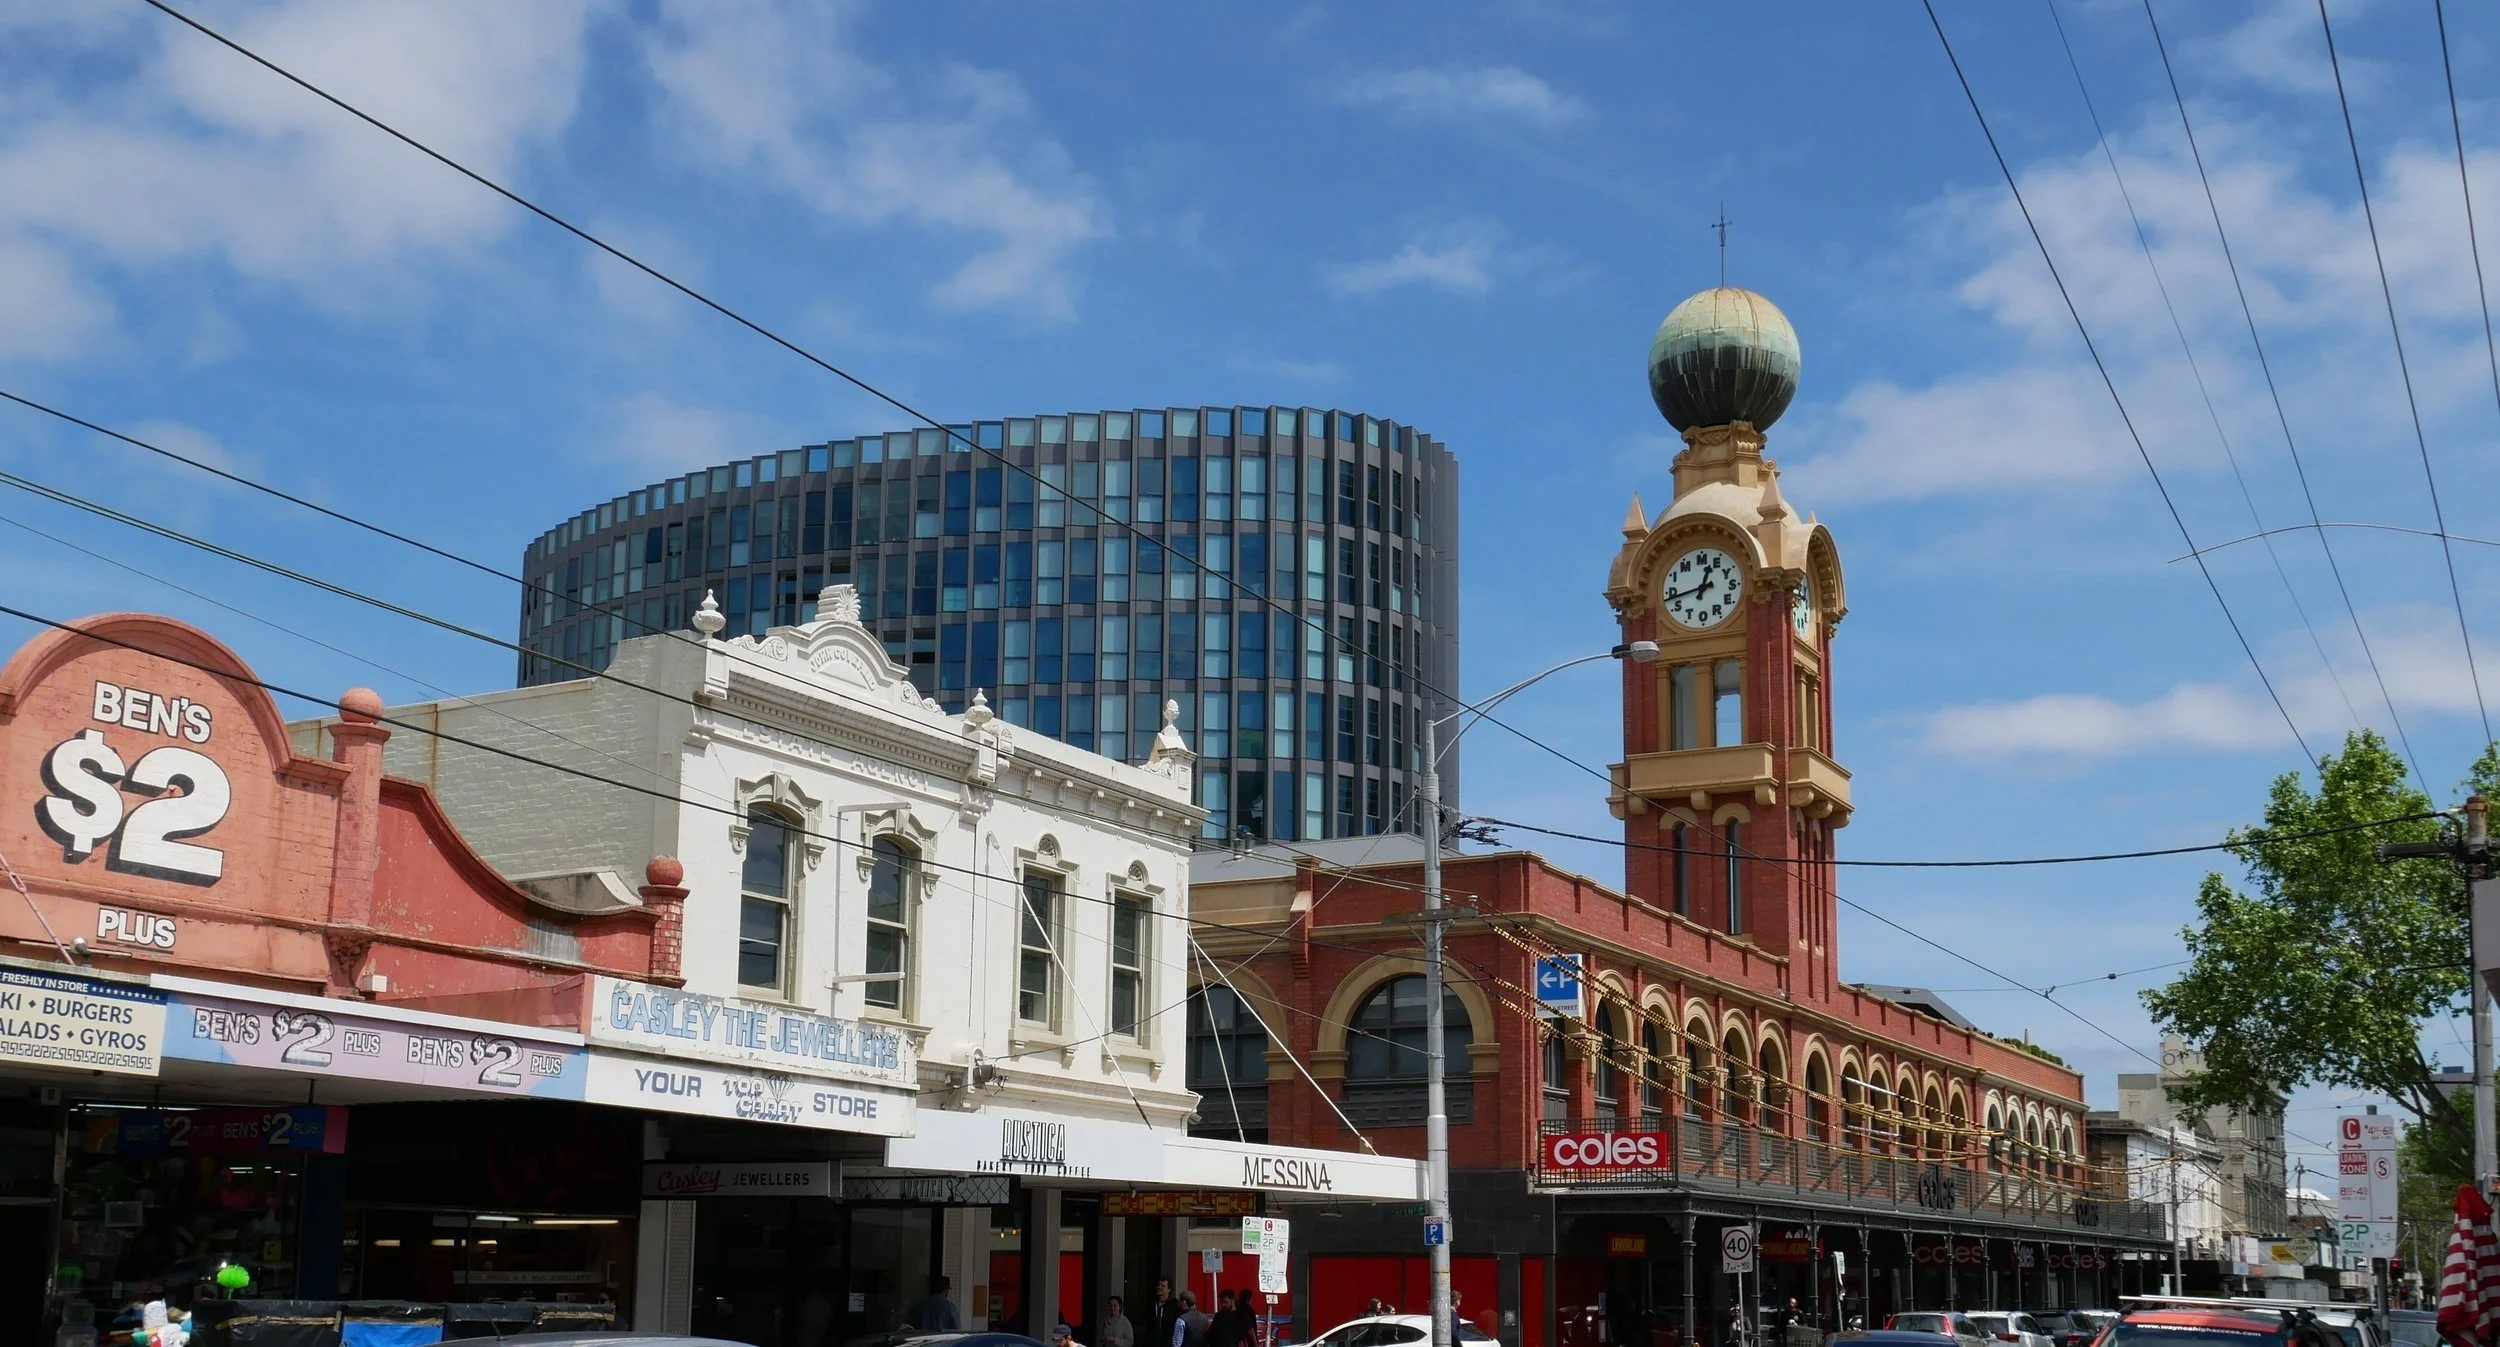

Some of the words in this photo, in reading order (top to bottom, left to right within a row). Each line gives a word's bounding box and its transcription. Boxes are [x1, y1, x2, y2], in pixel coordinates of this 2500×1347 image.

[93, 680, 212, 744] BEN'S
[742, 720, 832, 764] ESTATE
[34, 727, 231, 888] $2
[97, 907, 176, 948] PLUS
[2, 972, 45, 988] FRESHLY
[45, 980, 58, 989] IN
[58, 981, 89, 994] STORE
[43, 997, 133, 1025] BURGERS
[80, 1028, 147, 1051] GYROS
[611, 991, 720, 1042] CASLEY
[722, 1007, 767, 1049] THE
[770, 1017, 898, 1070] JEWELLERS
[193, 1008, 260, 1045] BEN'S
[272, 1008, 336, 1068] $2
[343, 1031, 381, 1055] PLUS
[407, 1035, 464, 1069] BEN'S
[470, 1035, 524, 1088] $2
[530, 1054, 563, 1076] PLUS
[635, 1069, 702, 1098] YOUR
[813, 1092, 878, 1119] STORE
[223, 1122, 258, 1138] BEN'S
[262, 1113, 293, 1145] $2
[293, 1123, 318, 1135] PLUS
[1002, 1119, 1066, 1161] RUSTICA
[1554, 1132, 1658, 1166] coles
[2340, 1154, 2366, 1163] LOADING
[658, 1165, 725, 1193] Casley
[732, 1172, 810, 1187] JEWELLERS
[1242, 1156, 1333, 1191] MESSINA
[2340, 1164, 2367, 1174] ZONE
[1263, 1238, 1274, 1247] 2P
[1430, 1225, 1438, 1235] P
[2341, 1224, 2369, 1240] 2P
[1726, 1237, 1747, 1253] 40
[1915, 1246, 1983, 1264] coes
[1261, 1275, 1272, 1284] 2P
